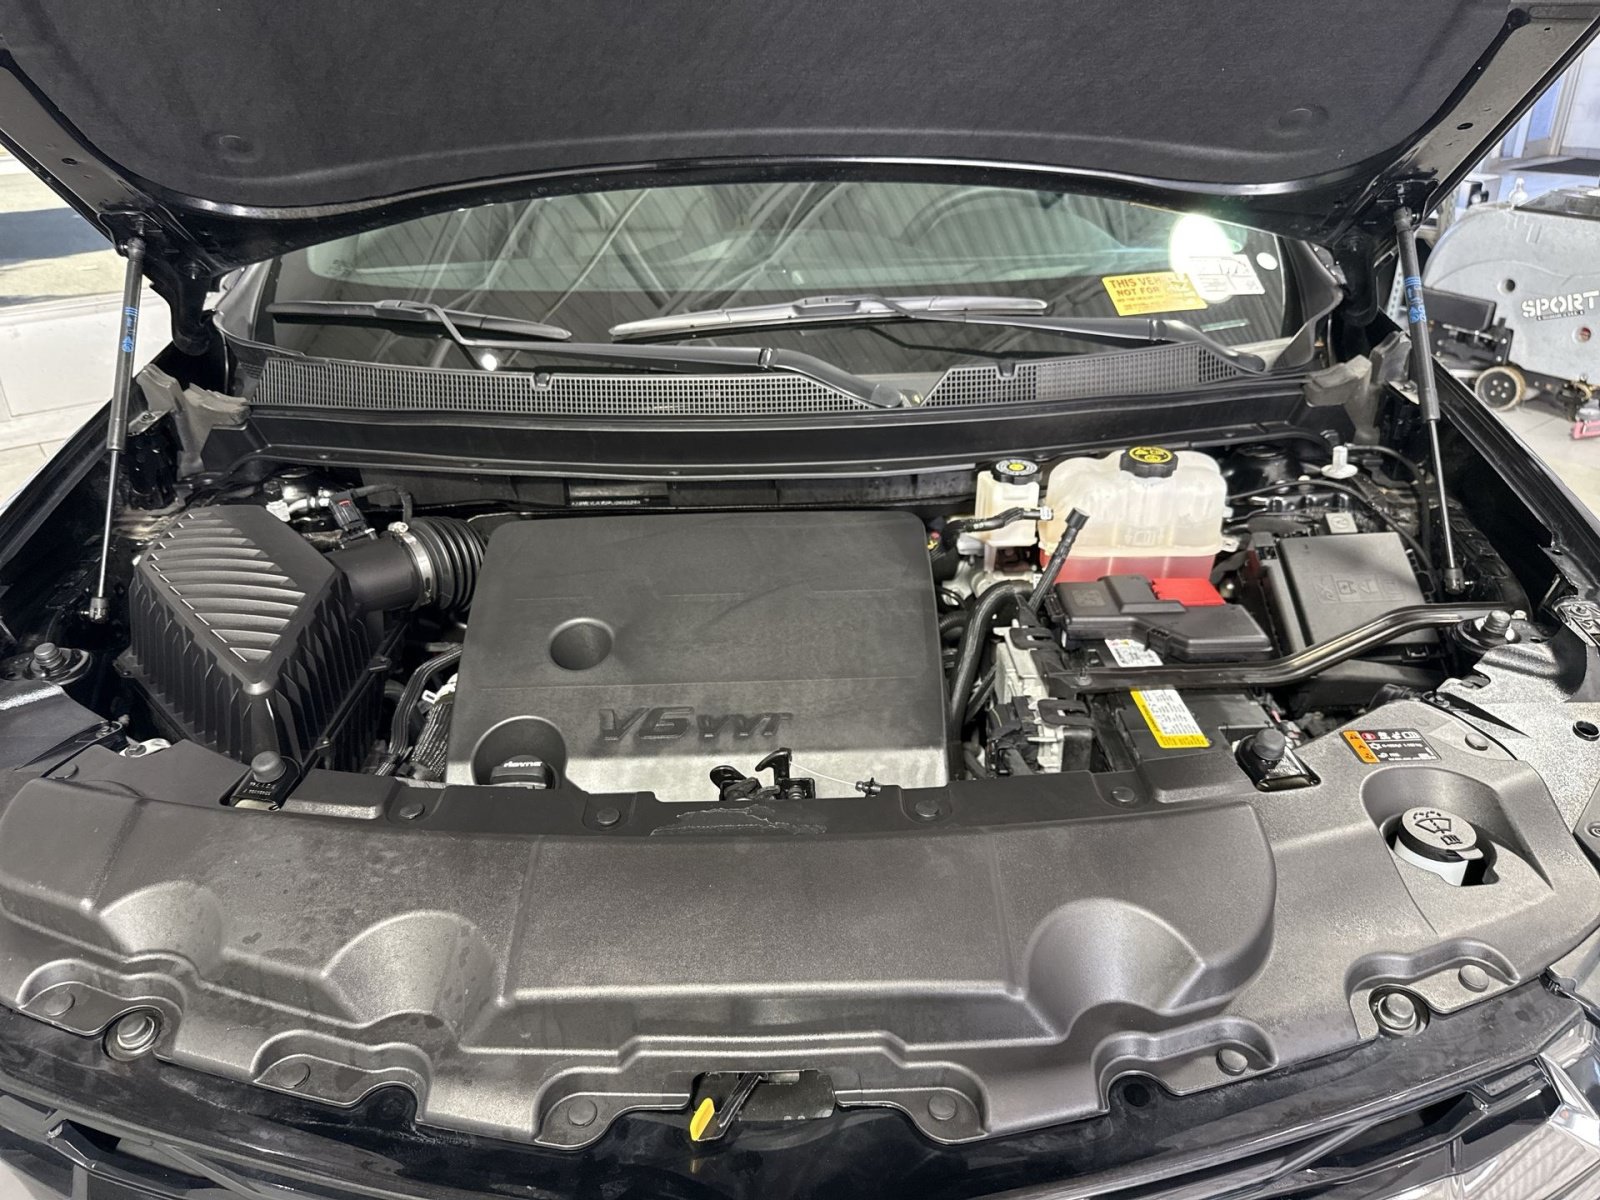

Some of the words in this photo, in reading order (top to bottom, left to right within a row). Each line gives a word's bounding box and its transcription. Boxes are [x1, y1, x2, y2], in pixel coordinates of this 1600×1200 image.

[1109, 278, 1137, 289] THIS
[1116, 288, 1137, 297] NOT
[1140, 286, 1160, 295] FOR
[1522, 290, 1600, 318] SPORT
[598, 706, 695, 741] V6
